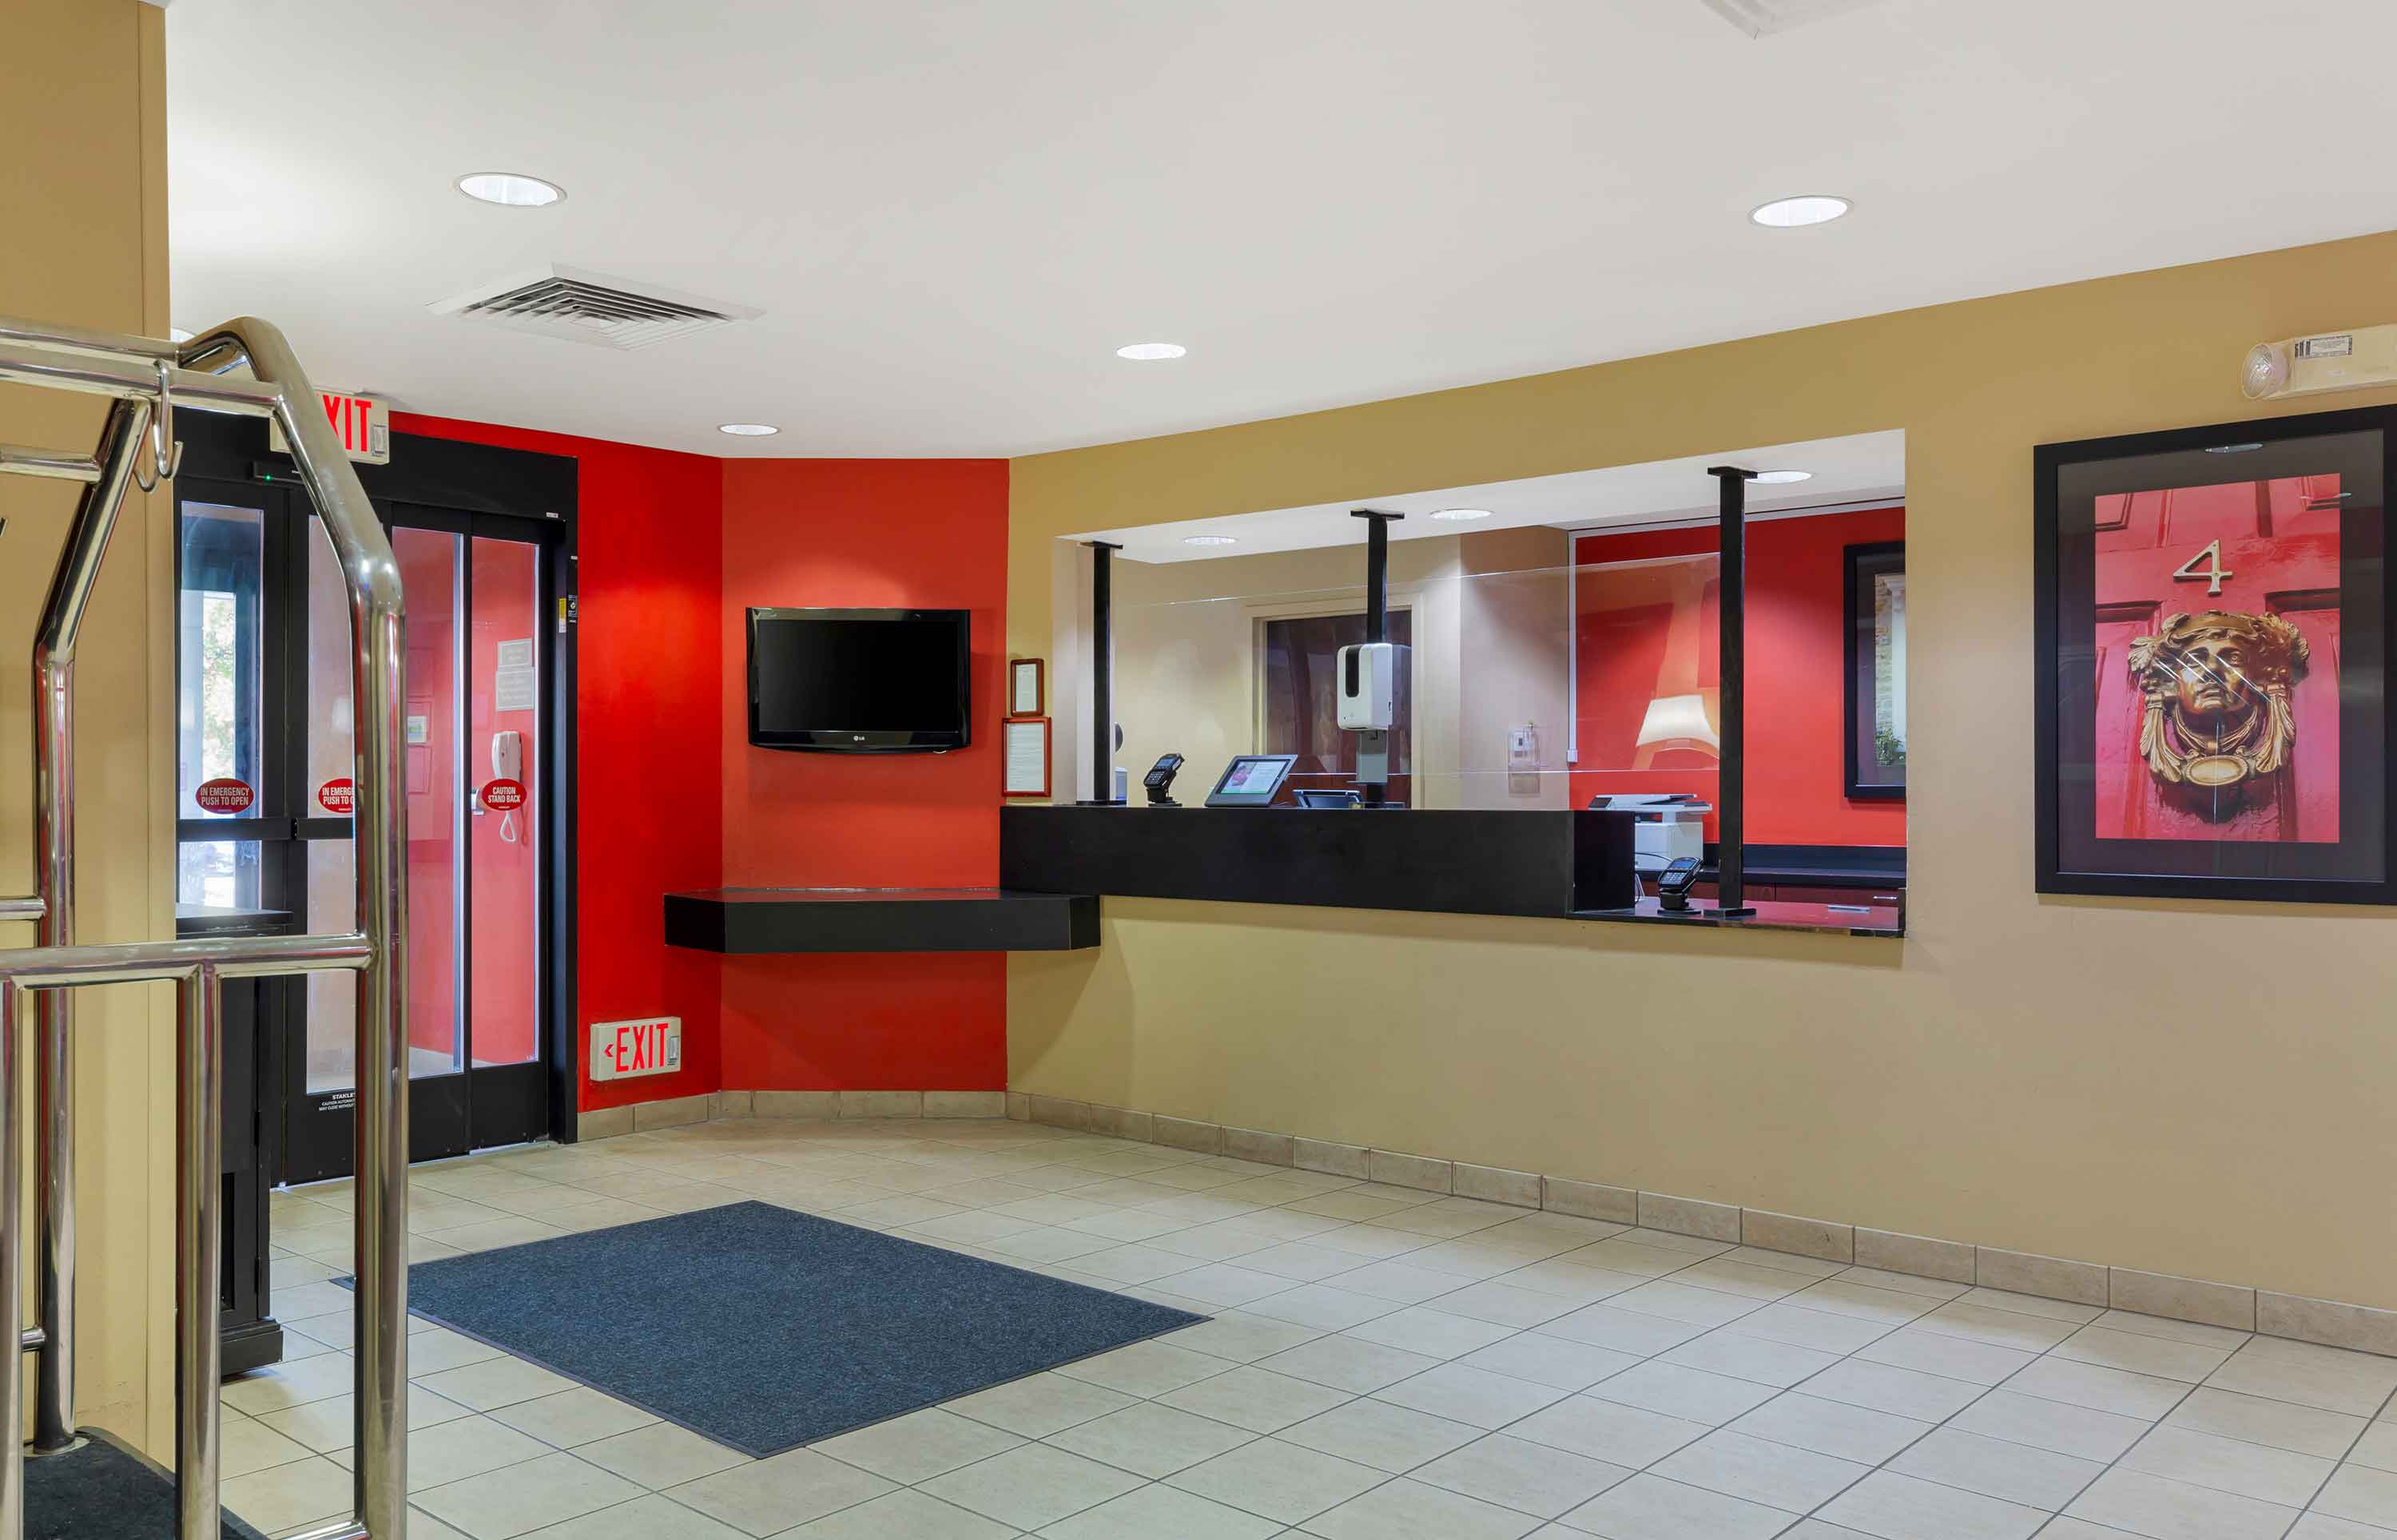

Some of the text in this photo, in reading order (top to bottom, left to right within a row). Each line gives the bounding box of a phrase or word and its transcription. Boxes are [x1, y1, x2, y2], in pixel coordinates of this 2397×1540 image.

[322, 394, 372, 453] XIT
[2172, 538, 2234, 593] 4
[200, 786, 249, 797] IN EMERGENCY
[322, 787, 352, 796] IN EMERG
[492, 786, 516, 795] CAUTION
[201, 796, 249, 806] PUSH TO OPEN
[323, 796, 340, 805] PUSH
[340, 796, 349, 805] TO
[487, 795, 521, 804] STAND BACK
[615, 1022, 669, 1074] EXIT
